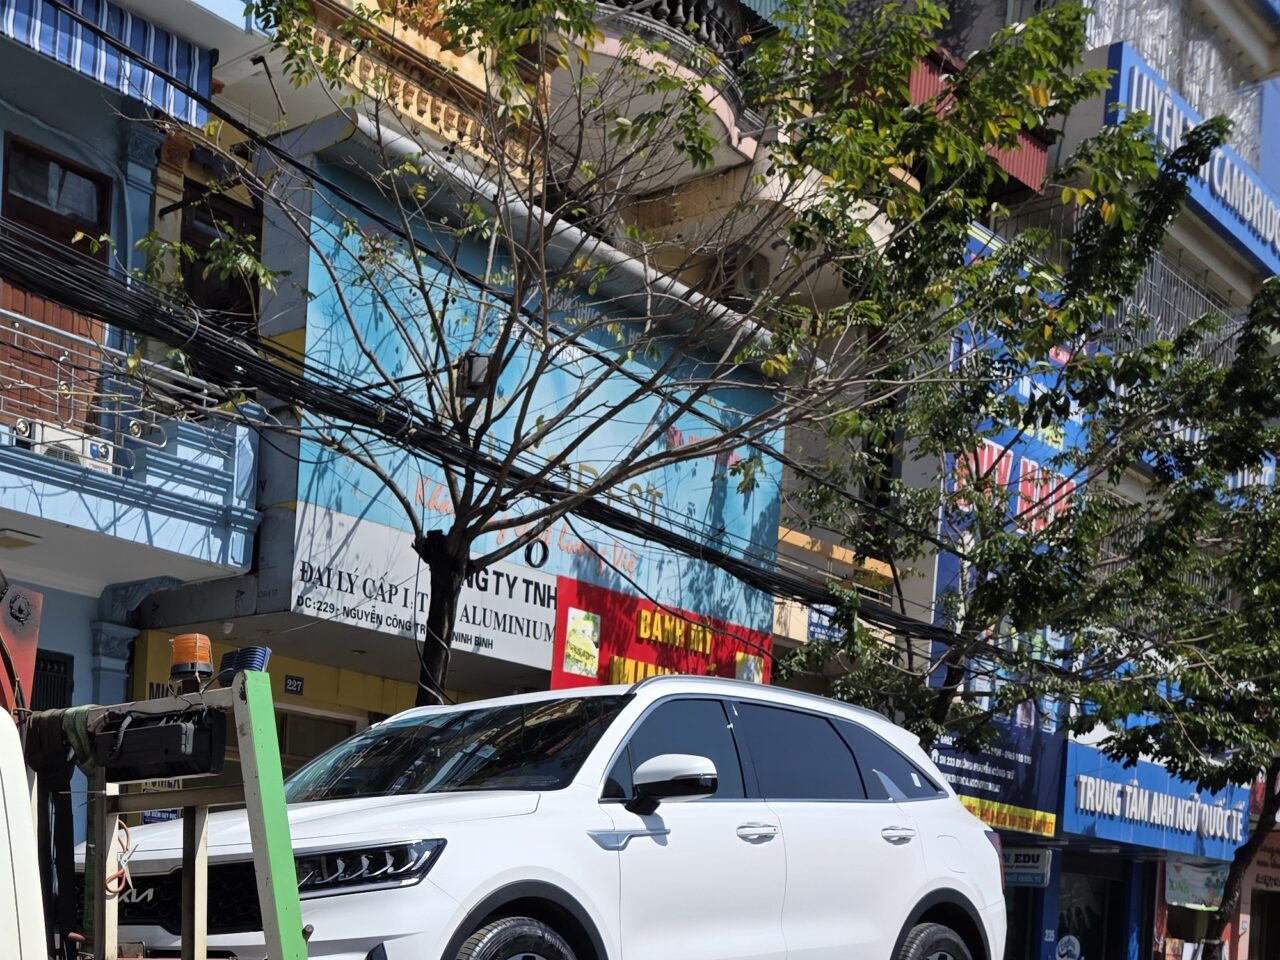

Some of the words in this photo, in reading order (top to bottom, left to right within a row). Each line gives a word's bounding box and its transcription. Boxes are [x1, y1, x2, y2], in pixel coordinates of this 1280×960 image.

[299, 559, 334, 590] ĐẠI
[337, 567, 359, 596] LÝ
[362, 571, 399, 605] CẤP
[492, 570, 518, 599] TY
[342, 605, 384, 626] NGUYỄN
[385, 613, 412, 632] CÔNG
[415, 622, 426, 635] TR
[636, 605, 686, 648] BÁNH
[286, 677, 303, 692] 227
[1076, 774, 1122, 817] TRUNG
[1124, 778, 1148, 822] TÂM
[1150, 791, 1174, 828] ANH
[1200, 797, 1230, 839] QUỐC
[1231, 800, 1244, 842] TẾ
[1014, 853, 1041, 864] EDU
